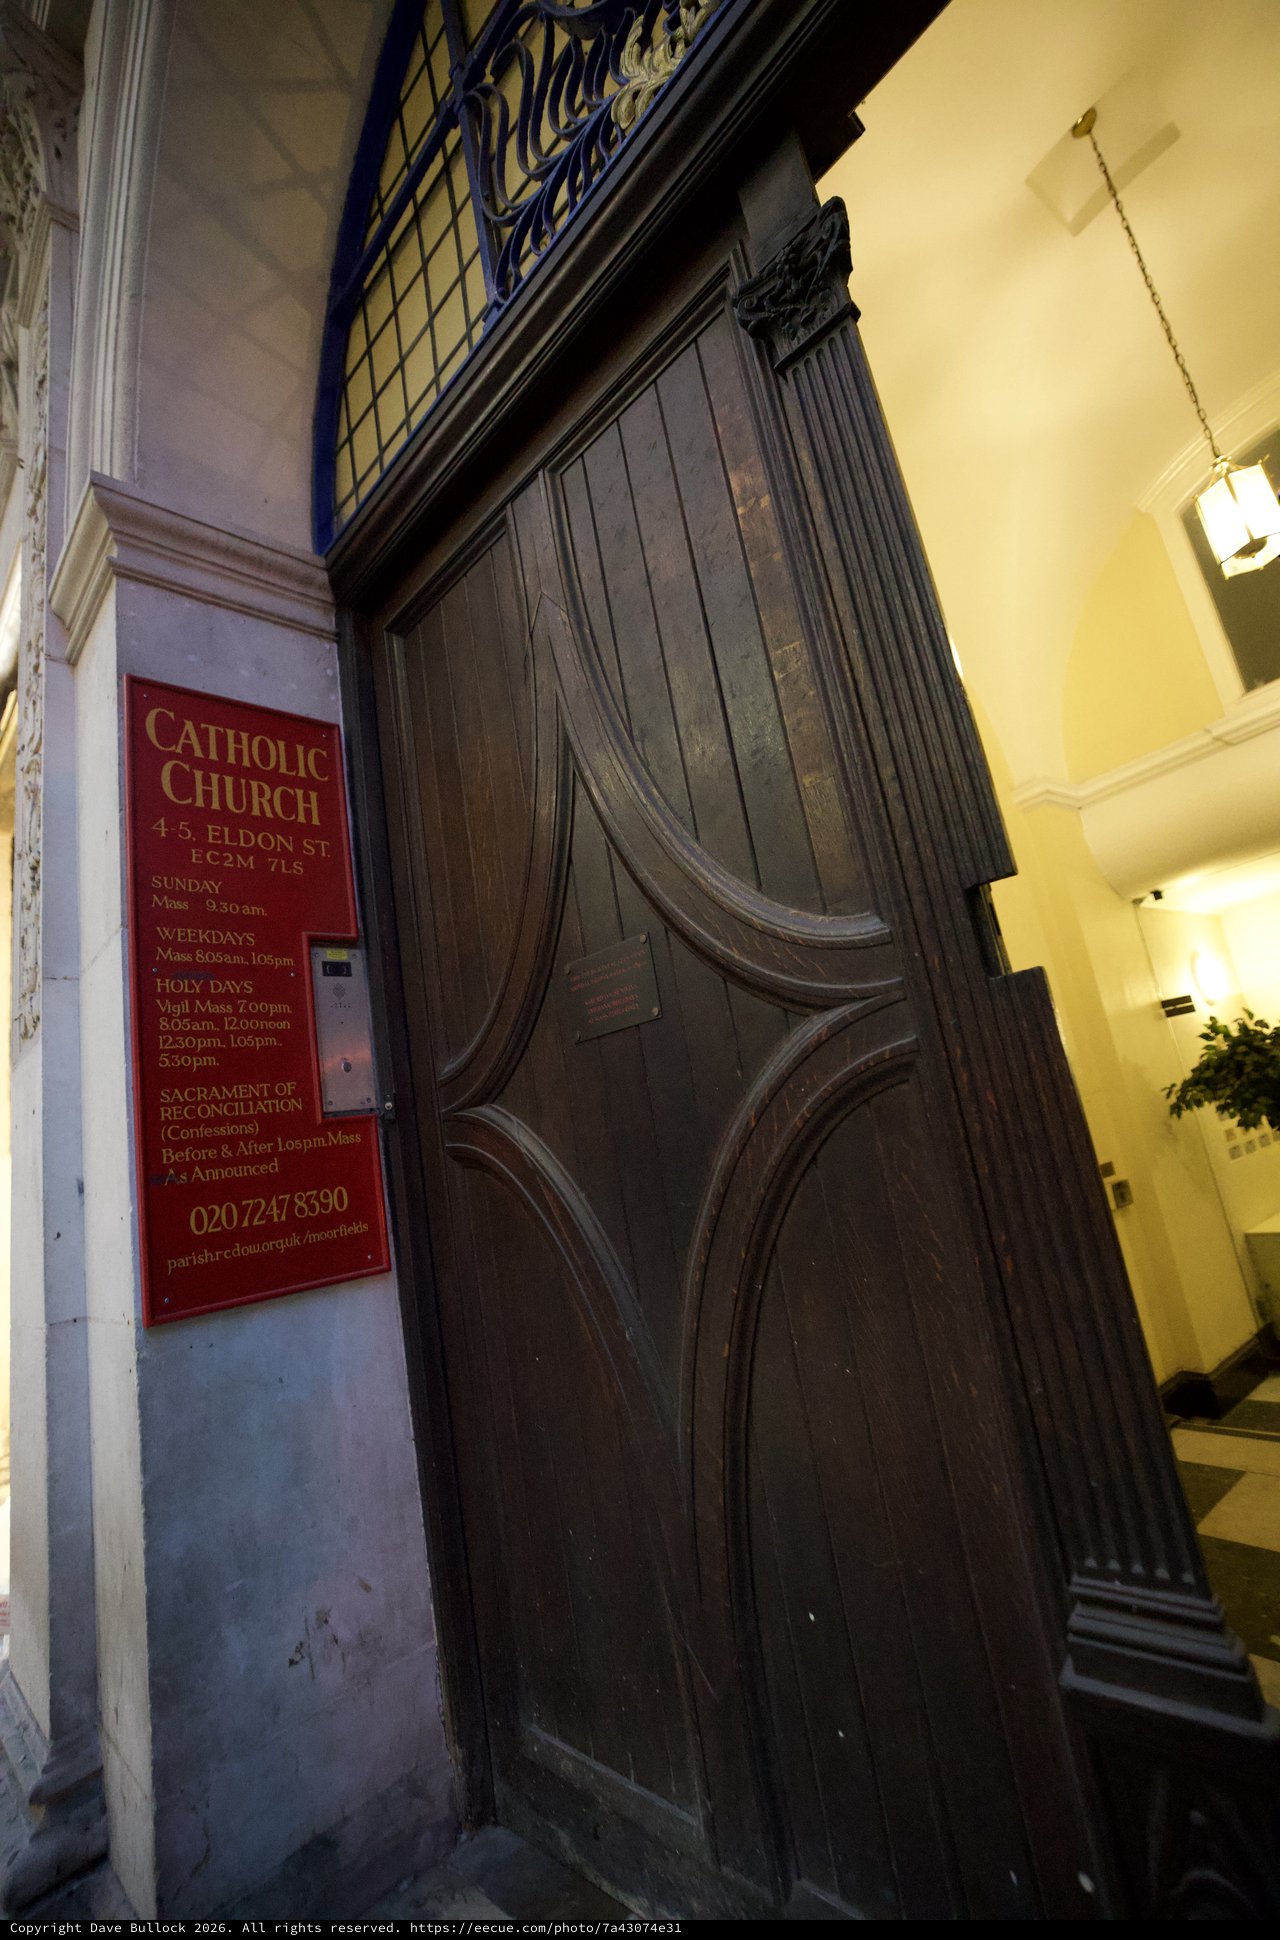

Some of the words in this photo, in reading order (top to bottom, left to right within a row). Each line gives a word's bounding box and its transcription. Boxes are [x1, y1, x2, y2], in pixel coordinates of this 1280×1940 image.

[145, 708, 329, 781] CATHOLIC
[161, 760, 321, 826] CHURCH
[207, 824, 294, 853] ELDON
[302, 838, 332, 858] ST.
[191, 849, 255, 870] EC2M
[268, 857, 304, 875] 7LS
[151, 875, 222, 894] SUNDAY
[151, 894, 189, 910] Mass
[156, 926, 255, 946] WEEKDAYS
[156, 946, 193, 962] Mass
[156, 978, 204, 994] HOLY
[209, 980, 254, 994] DAYS
[156, 999, 190, 1017] Vigil
[194, 1000, 233, 1014] Mass
[160, 1083, 271, 1103] SACRAMENT
[274, 1082, 297, 1096] OF
[160, 1098, 303, 1121] RECONCILIATION
[161, 1120, 260, 1142] (Confessions)
[162, 1145, 217, 1164] Before
[221, 1143, 234, 1158] &
[236, 1140, 274, 1156] After
[327, 1130, 362, 1147] Mass
[163, 1168, 188, 1186] As
[191, 1157, 280, 1182] Announced
[189, 1202, 239, 1235] 020
[241, 1194, 291, 1228] 7247
[294, 1186, 349, 1218] 8390
